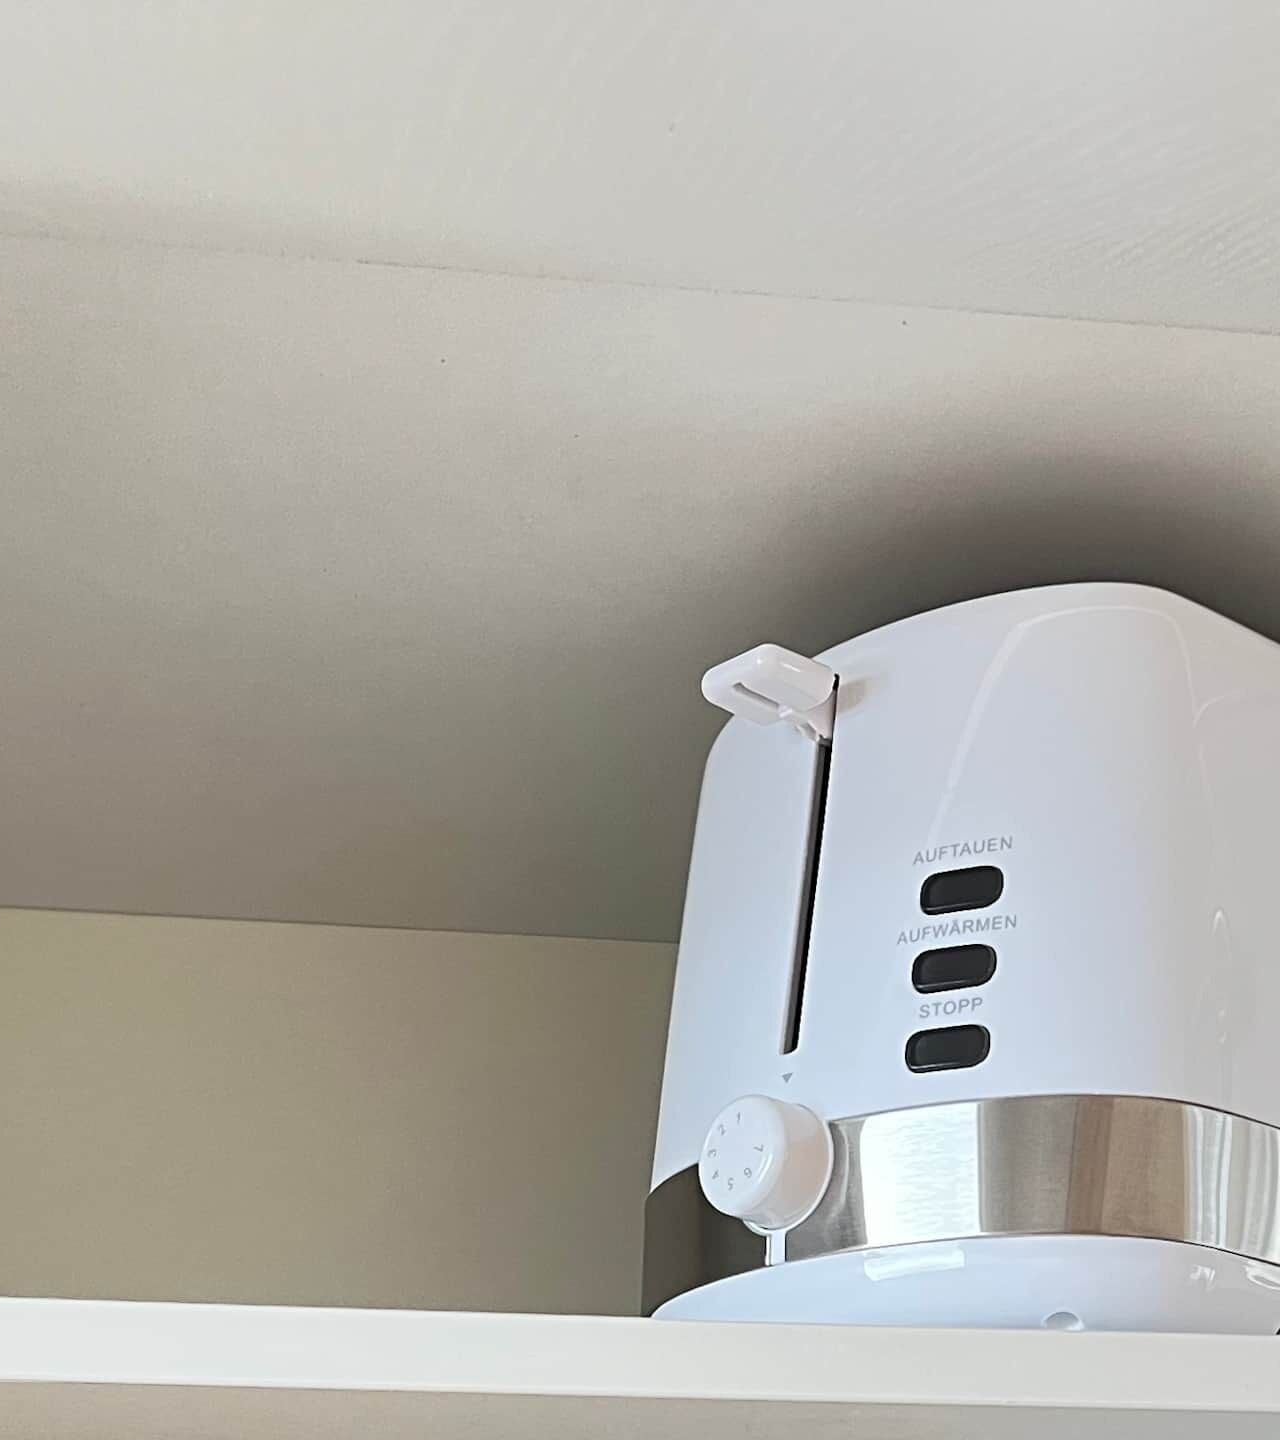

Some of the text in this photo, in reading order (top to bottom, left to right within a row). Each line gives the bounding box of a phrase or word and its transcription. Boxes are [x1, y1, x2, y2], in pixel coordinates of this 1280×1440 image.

[912, 836, 1014, 865] AUFTAUEN
[896, 915, 1017, 946] AUFWÄRMEN
[919, 997, 984, 1019] STOPP
